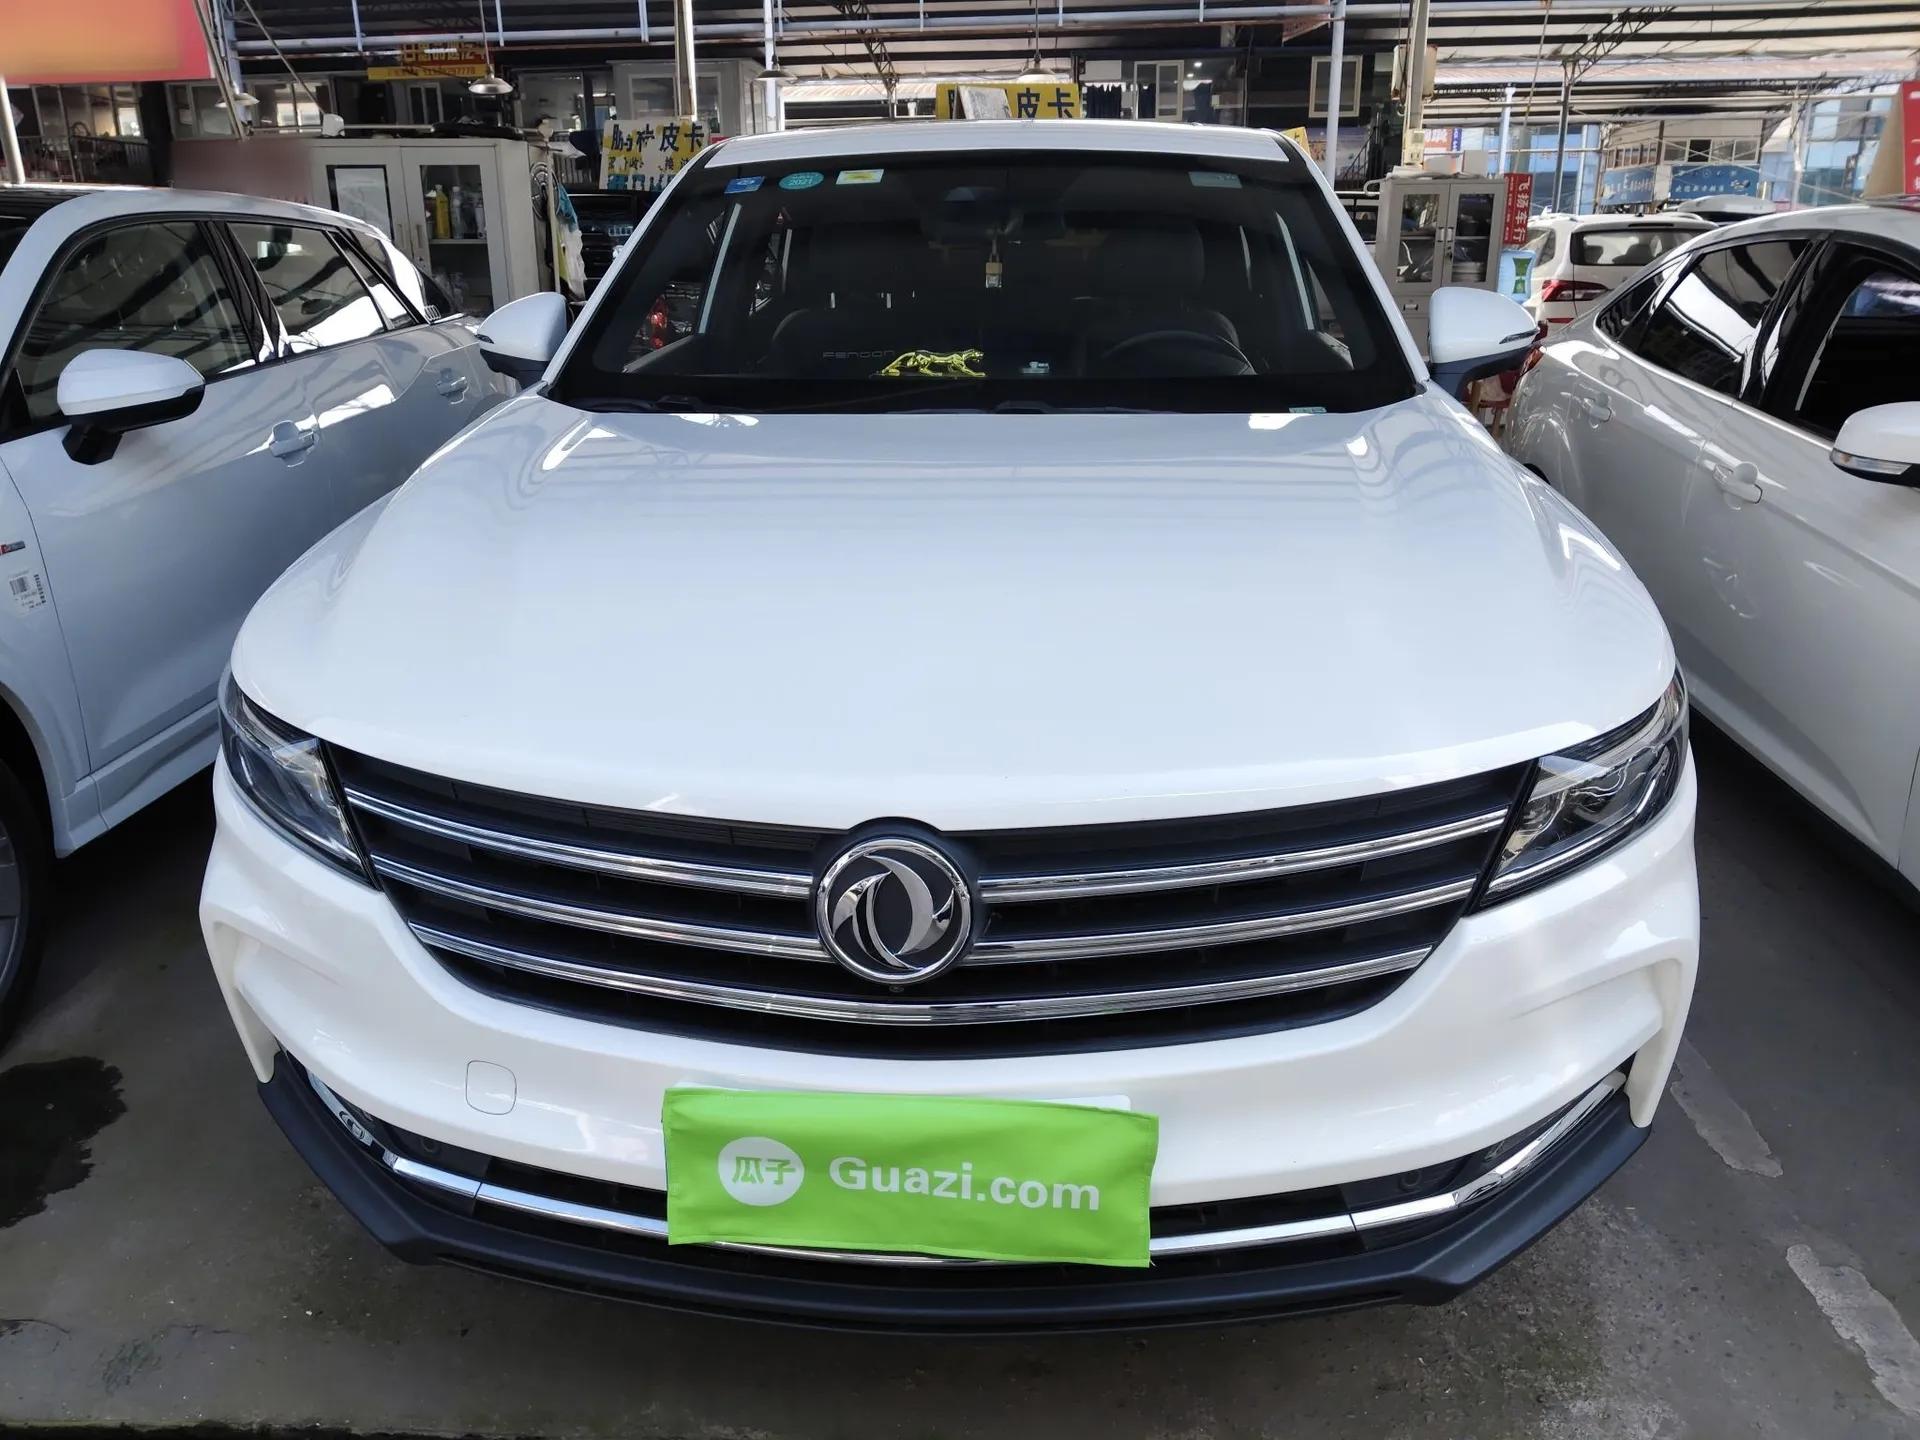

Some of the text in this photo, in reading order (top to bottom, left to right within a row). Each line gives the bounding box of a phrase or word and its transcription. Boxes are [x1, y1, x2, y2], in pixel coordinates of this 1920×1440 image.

[1512, 175, 1531, 242] 飞扬车行
[732, 1155, 798, 1187] 瓜子
[829, 1156, 1100, 1211] Guazi.com
